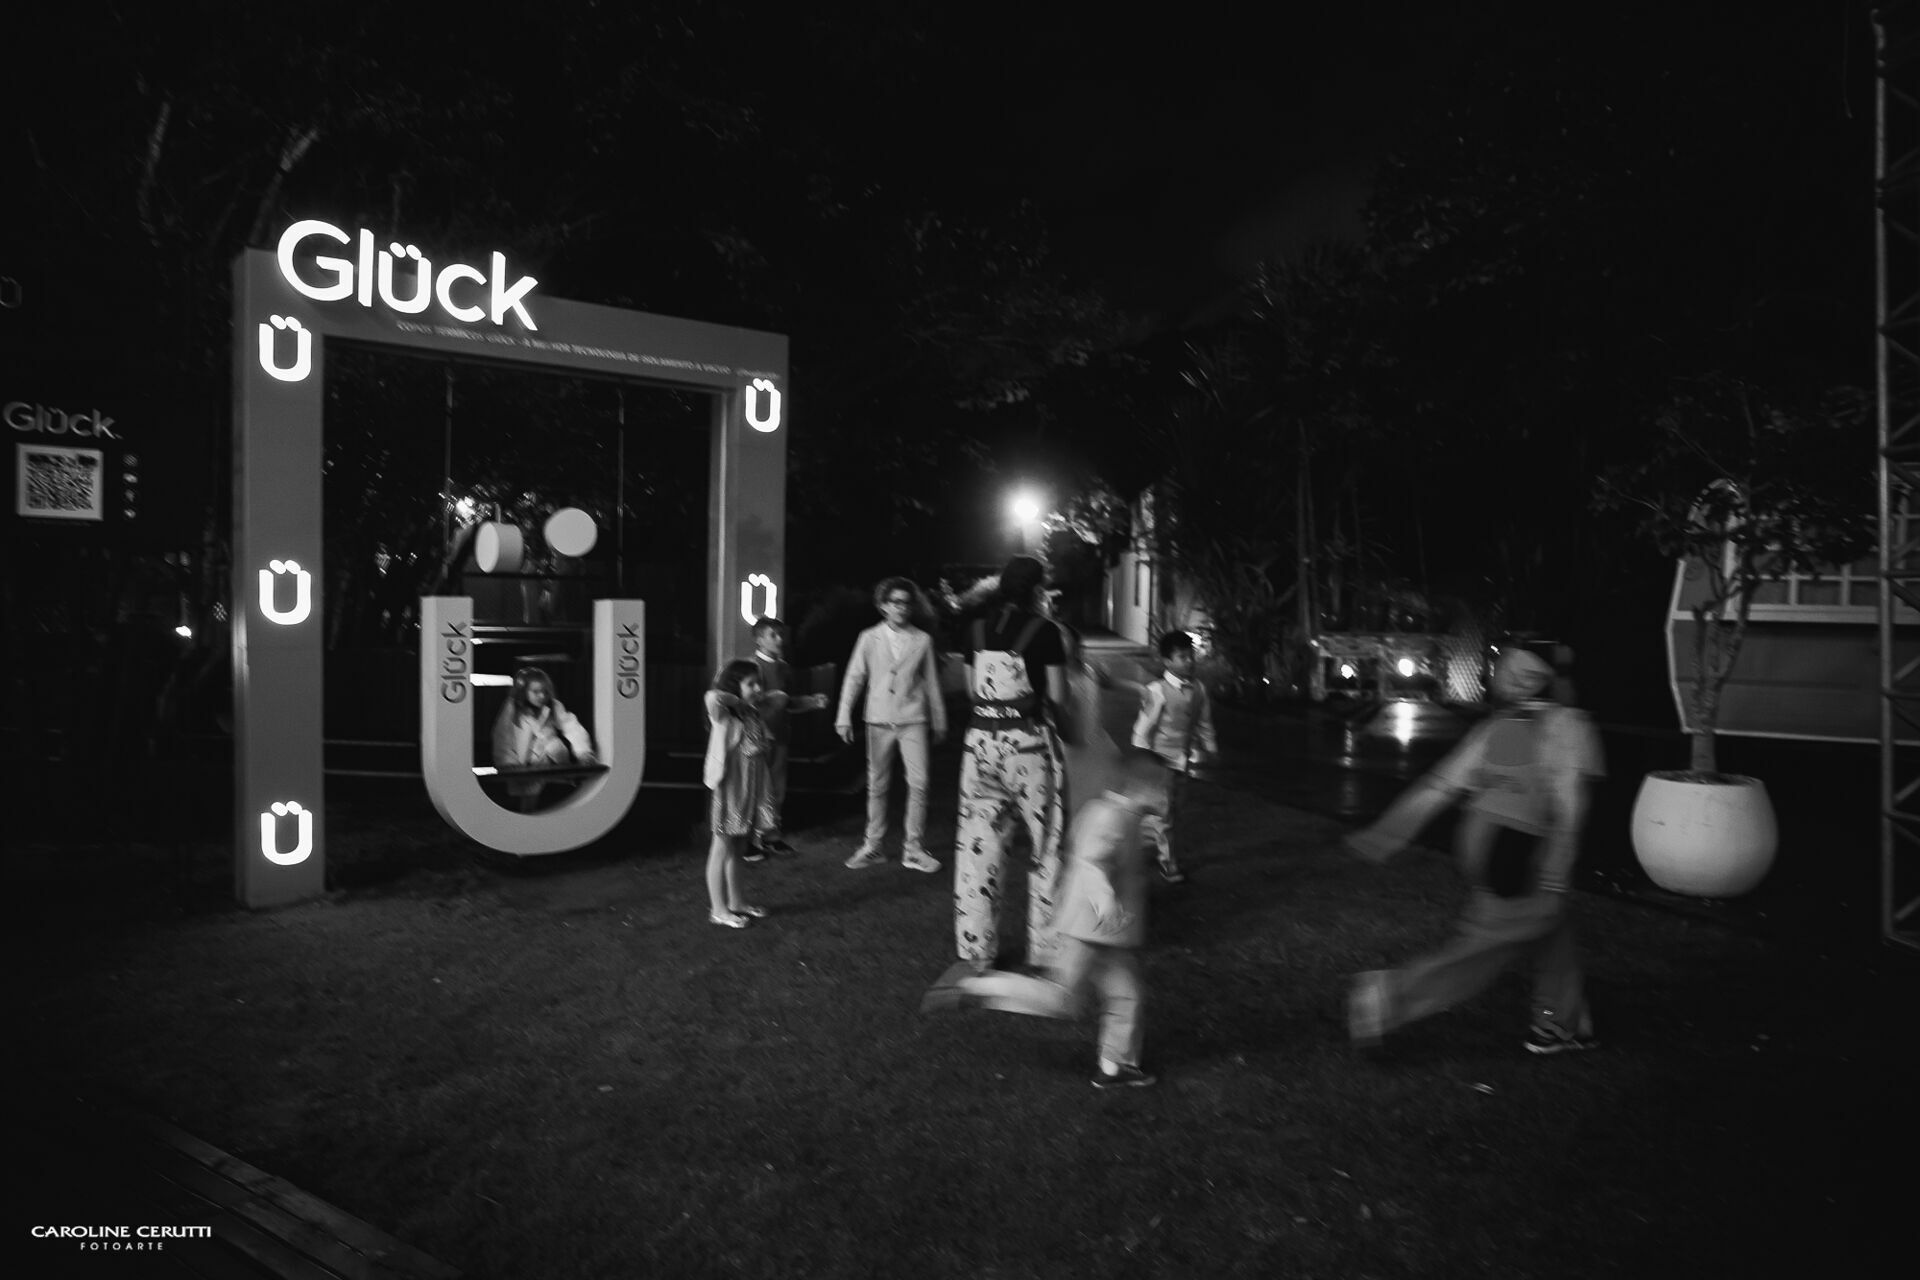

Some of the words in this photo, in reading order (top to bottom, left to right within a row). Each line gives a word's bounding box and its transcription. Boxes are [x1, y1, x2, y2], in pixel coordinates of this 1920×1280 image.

[277, 220, 538, 333] Glück
[3, 401, 117, 440] Glück
[441, 620, 471, 704] Glück
[616, 622, 641, 700] Glück
